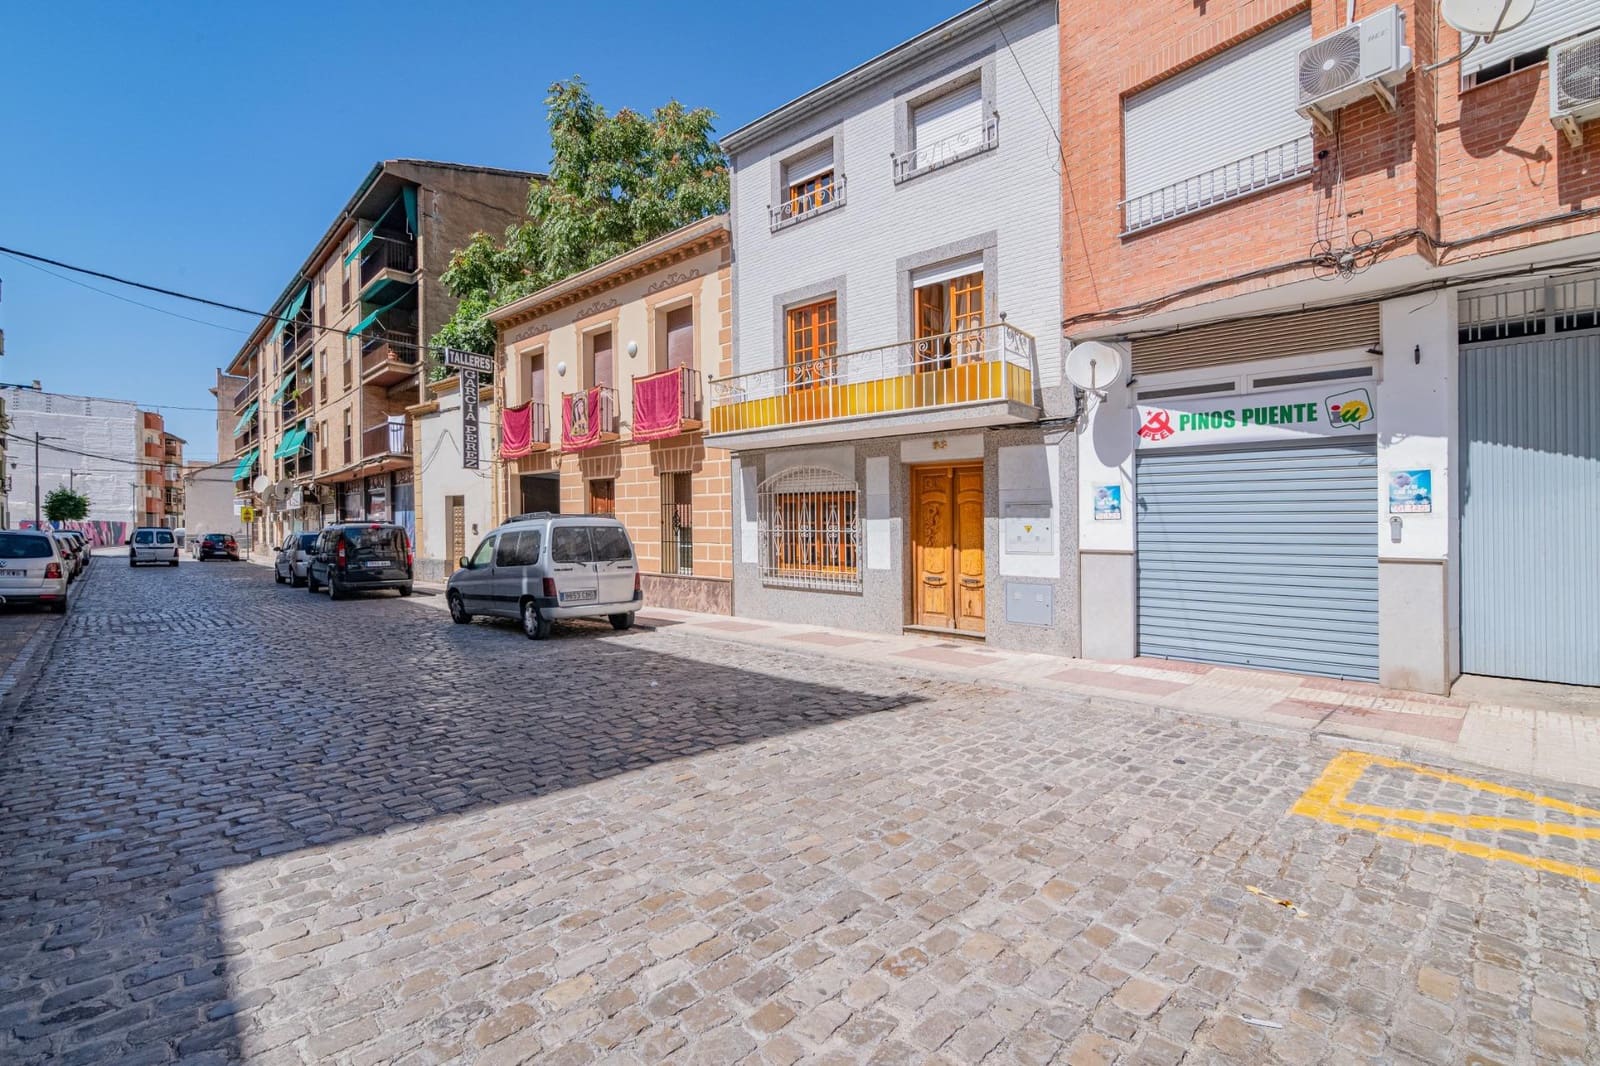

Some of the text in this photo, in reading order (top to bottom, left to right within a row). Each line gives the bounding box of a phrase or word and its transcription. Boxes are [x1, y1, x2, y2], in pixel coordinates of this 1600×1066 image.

[449, 350, 492, 370] TALLERES
[464, 370, 477, 468] GARCIA PEREZ
[1179, 402, 1318, 431] PINOS PUENTE
[1142, 430, 1169, 441] PCE
